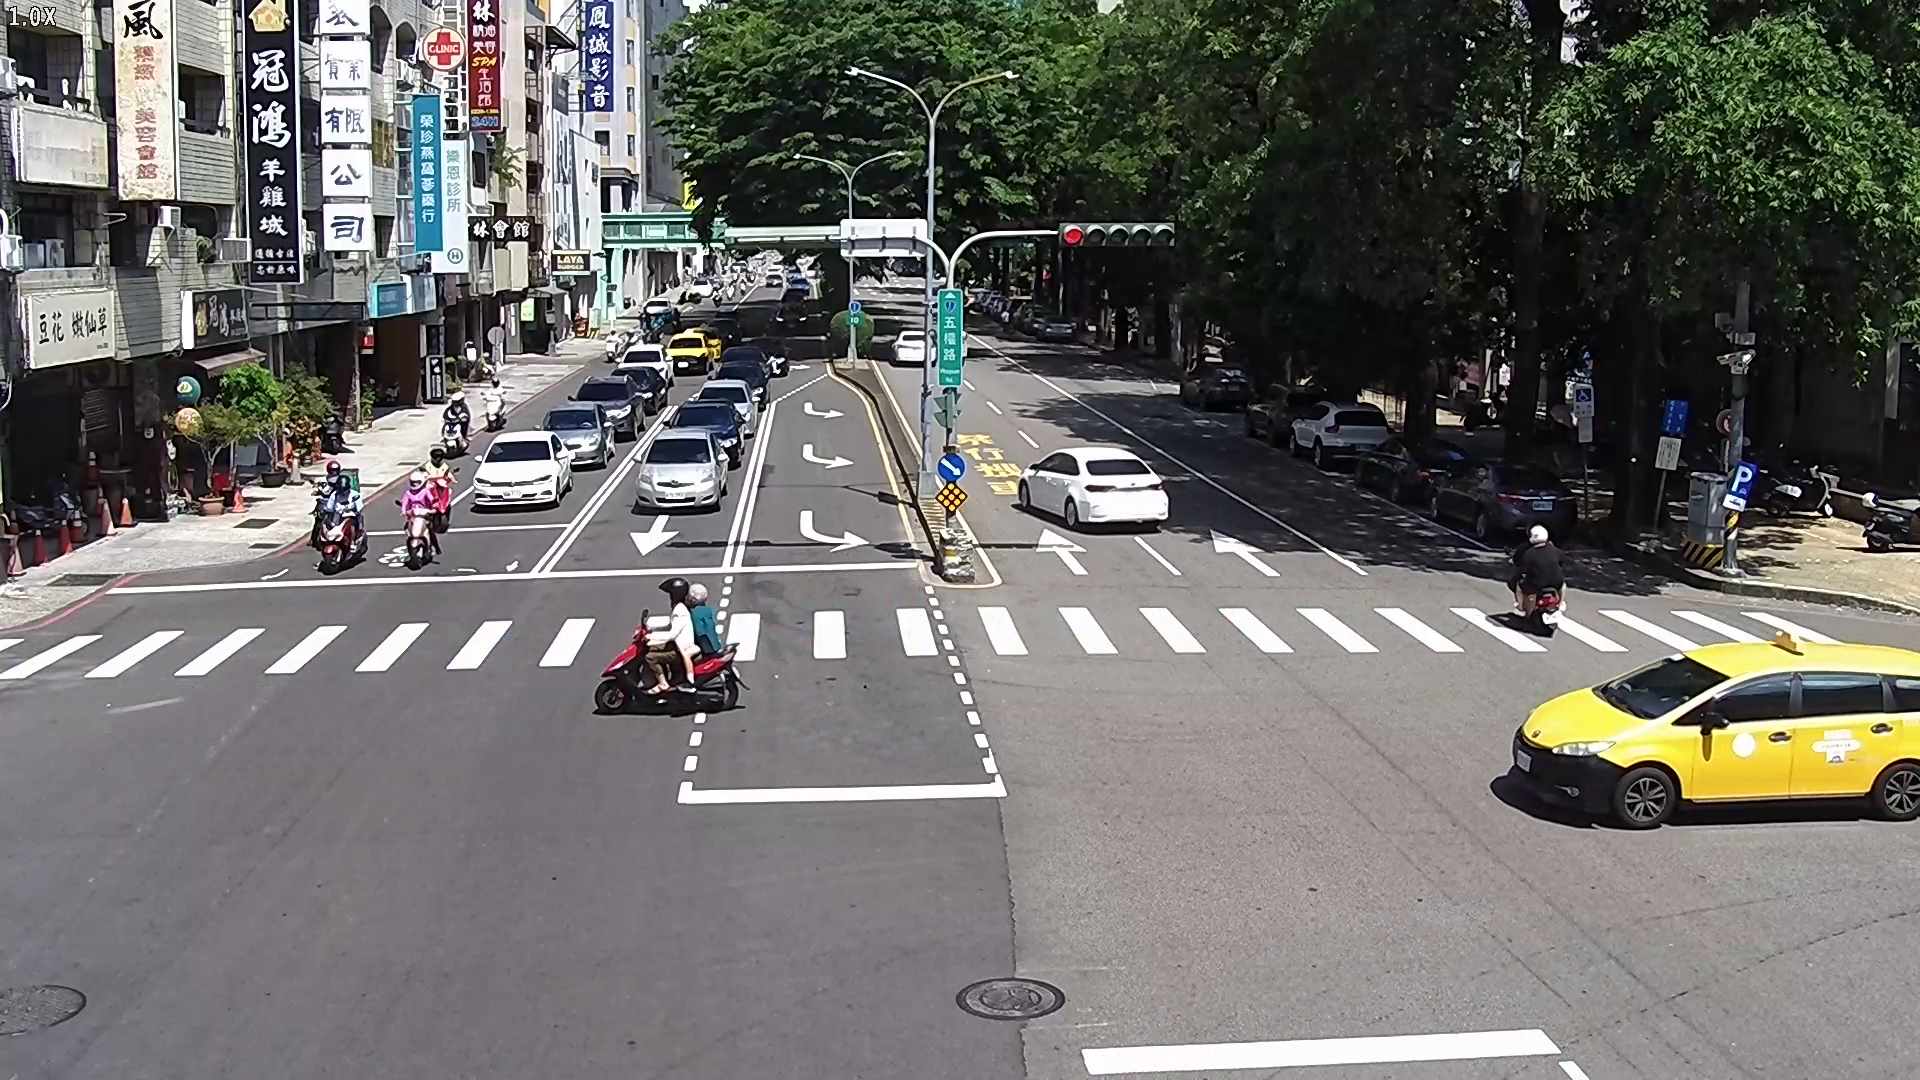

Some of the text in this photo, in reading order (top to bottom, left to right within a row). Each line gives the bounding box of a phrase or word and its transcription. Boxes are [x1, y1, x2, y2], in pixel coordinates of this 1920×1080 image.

[123, 0, 163, 39] 風
[428, 44, 459, 54] CLINIC
[471, 56, 498, 68] SPA
[251, 49, 292, 149] 冠鴻
[259, 158, 288, 236] 羊雞城
[557, 255, 585, 264] LAYA
[39, 311, 65, 345] 豆花
[943, 316, 957, 361] 五權路
[1731, 465, 1753, 492] P
